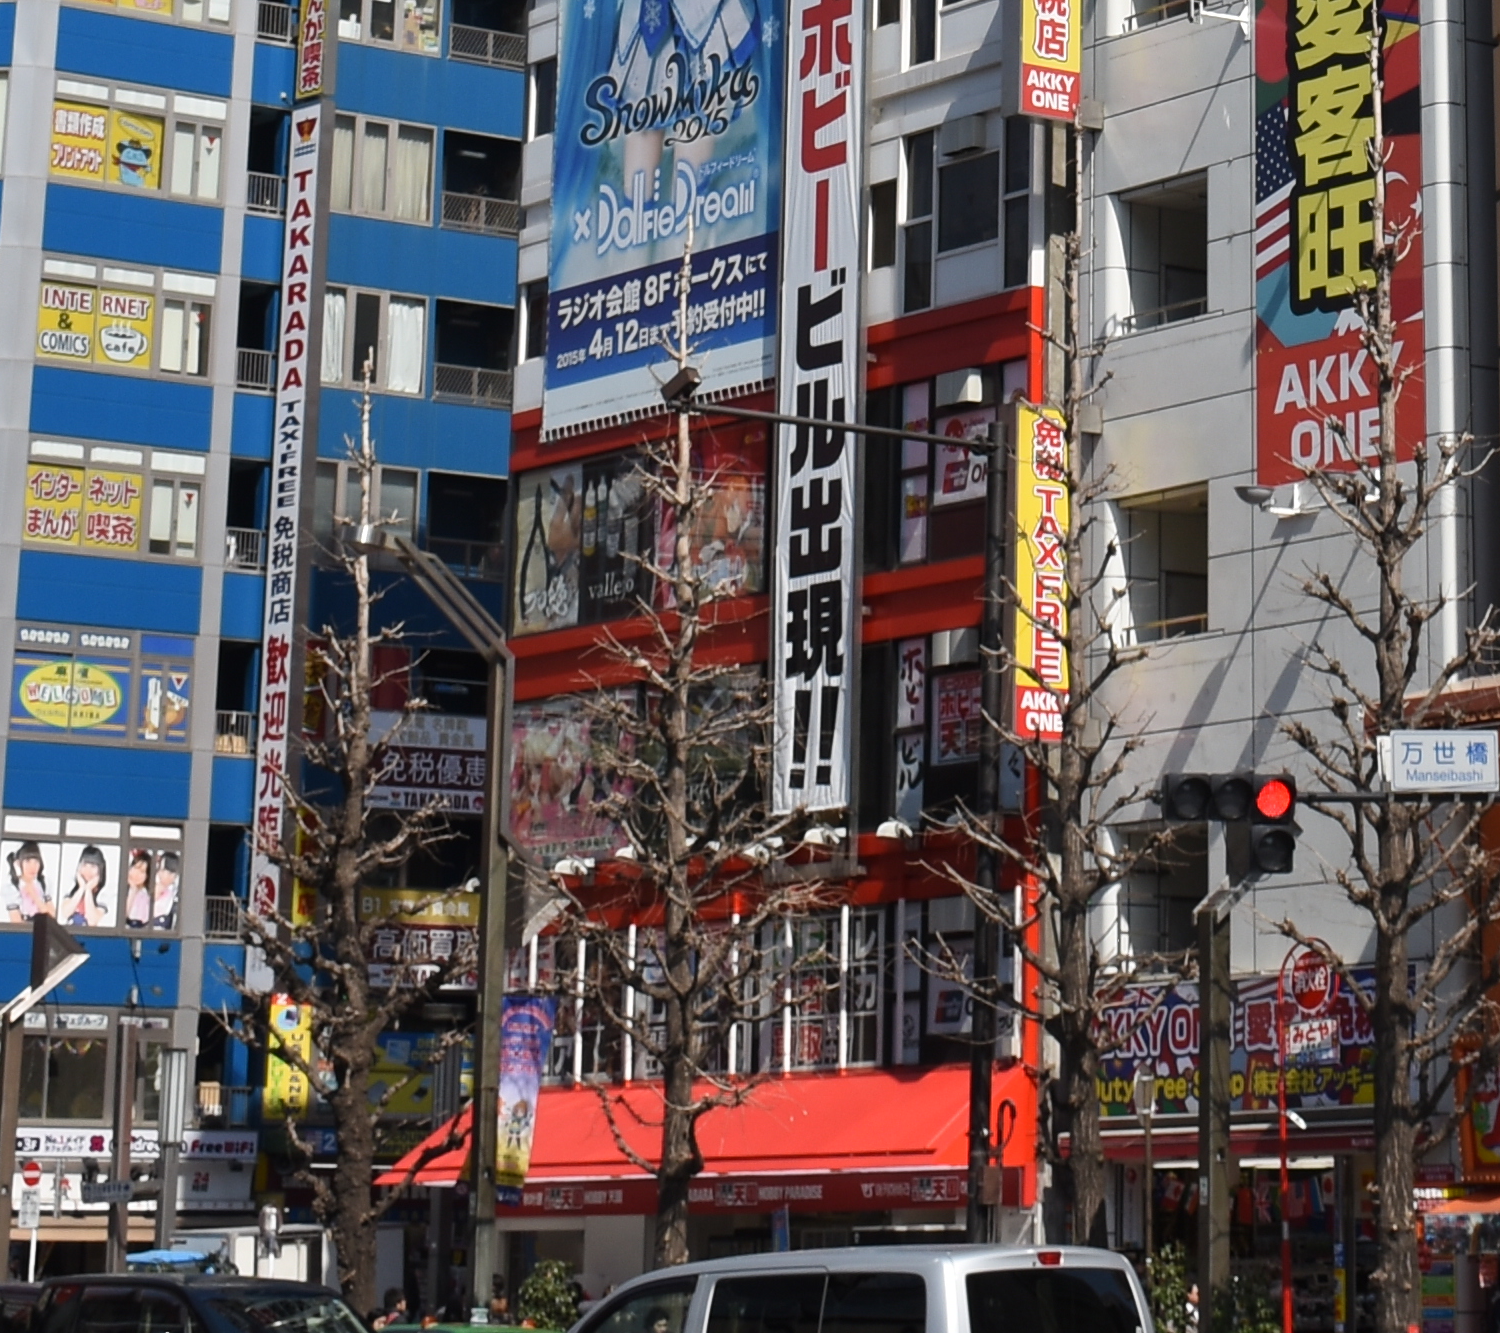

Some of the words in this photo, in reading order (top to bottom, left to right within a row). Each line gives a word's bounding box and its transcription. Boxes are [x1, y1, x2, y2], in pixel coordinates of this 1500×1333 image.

[1026, 70, 1078, 92] AKKY
[1030, 91, 1071, 113] ONE
[663, 116, 728, 147] 2015
[282, 168, 315, 393] TAKARADA
[57, 312, 72, 329] &
[39, 331, 90, 356] COMICS
[104, 339, 136, 355] cafe
[1033, 485, 1064, 570] TAX
[268, 515, 295, 625] 免税商店
[588, 570, 635, 602] vallejo
[1032, 570, 1063, 684] FREE
[26, 682, 118, 708] WELCOME
[1025, 710, 1064, 734] ONE
[1401, 740, 1489, 766] 万世橋
[1405, 767, 1484, 783] Manseibashi
[1291, 1025, 1330, 1044] みとや
